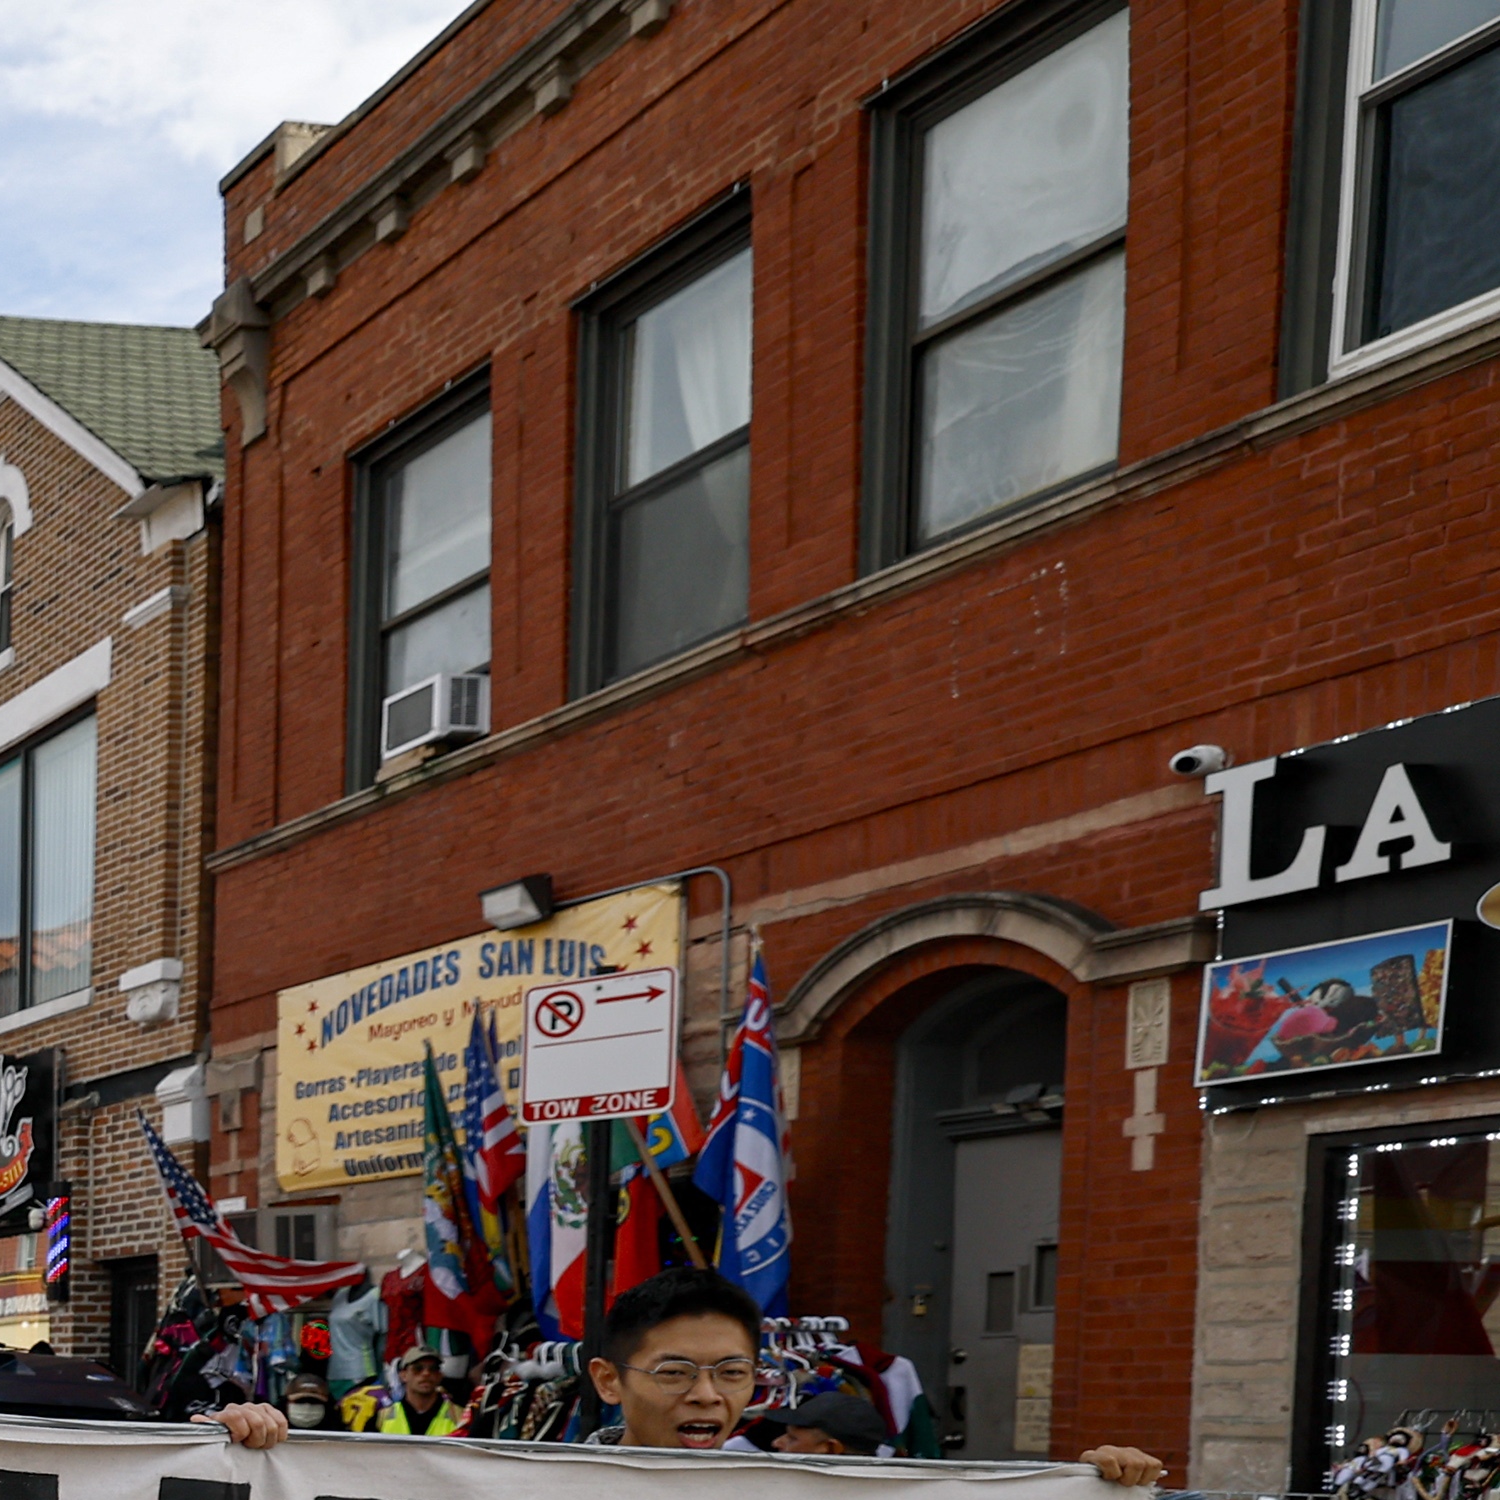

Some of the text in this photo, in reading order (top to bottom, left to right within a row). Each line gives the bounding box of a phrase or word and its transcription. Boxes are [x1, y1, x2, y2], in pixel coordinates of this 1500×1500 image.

[1199, 757, 1452, 912] LA
[321, 938, 608, 1050] NOVEDADES SAN LUIS
[368, 985, 524, 1042] Mayoreo y Menud
[295, 1074, 346, 1101] Gorras
[329, 1089, 426, 1123] Accesorio
[529, 1089, 658, 1120] TOW ZONE
